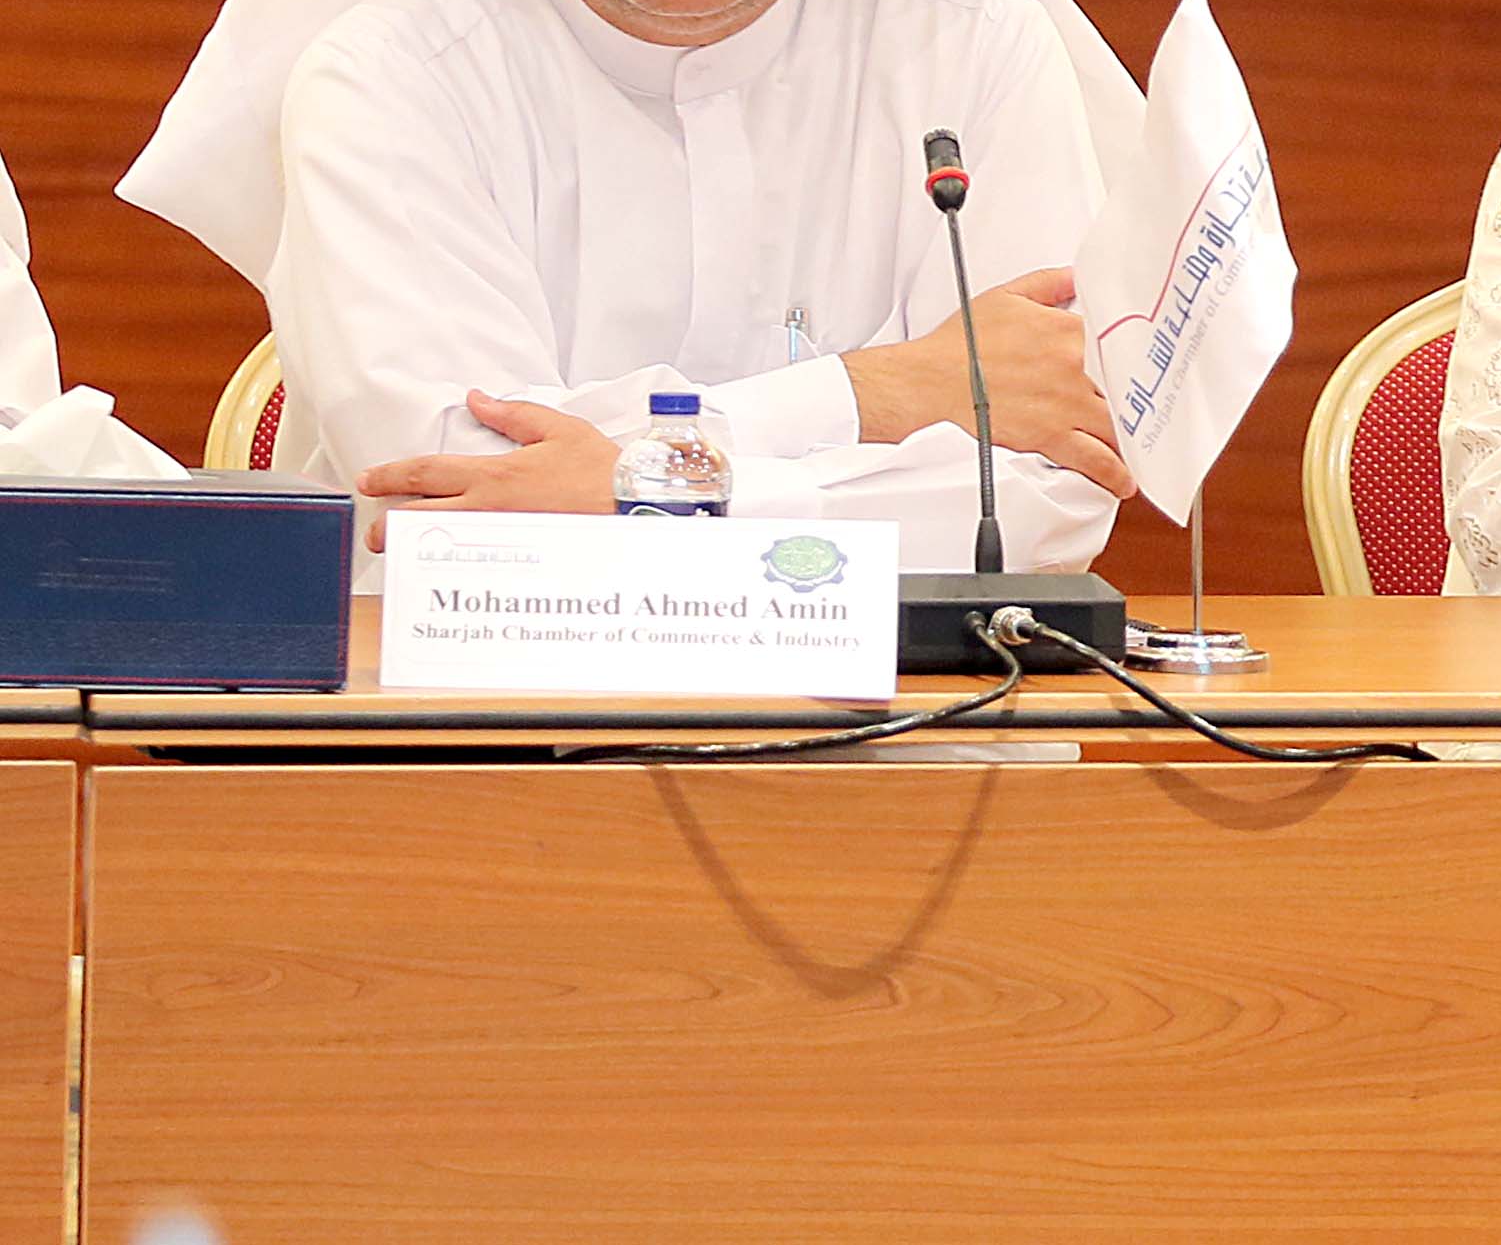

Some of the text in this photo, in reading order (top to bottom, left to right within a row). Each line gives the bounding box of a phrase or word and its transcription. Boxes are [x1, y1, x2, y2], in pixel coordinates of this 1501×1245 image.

[1119, 328, 1177, 438] الشارقة
[430, 589, 846, 620] Mohammed Ahmed Amin
[411, 623, 862, 649] Sharjah Chamber of Commerce & Industry
